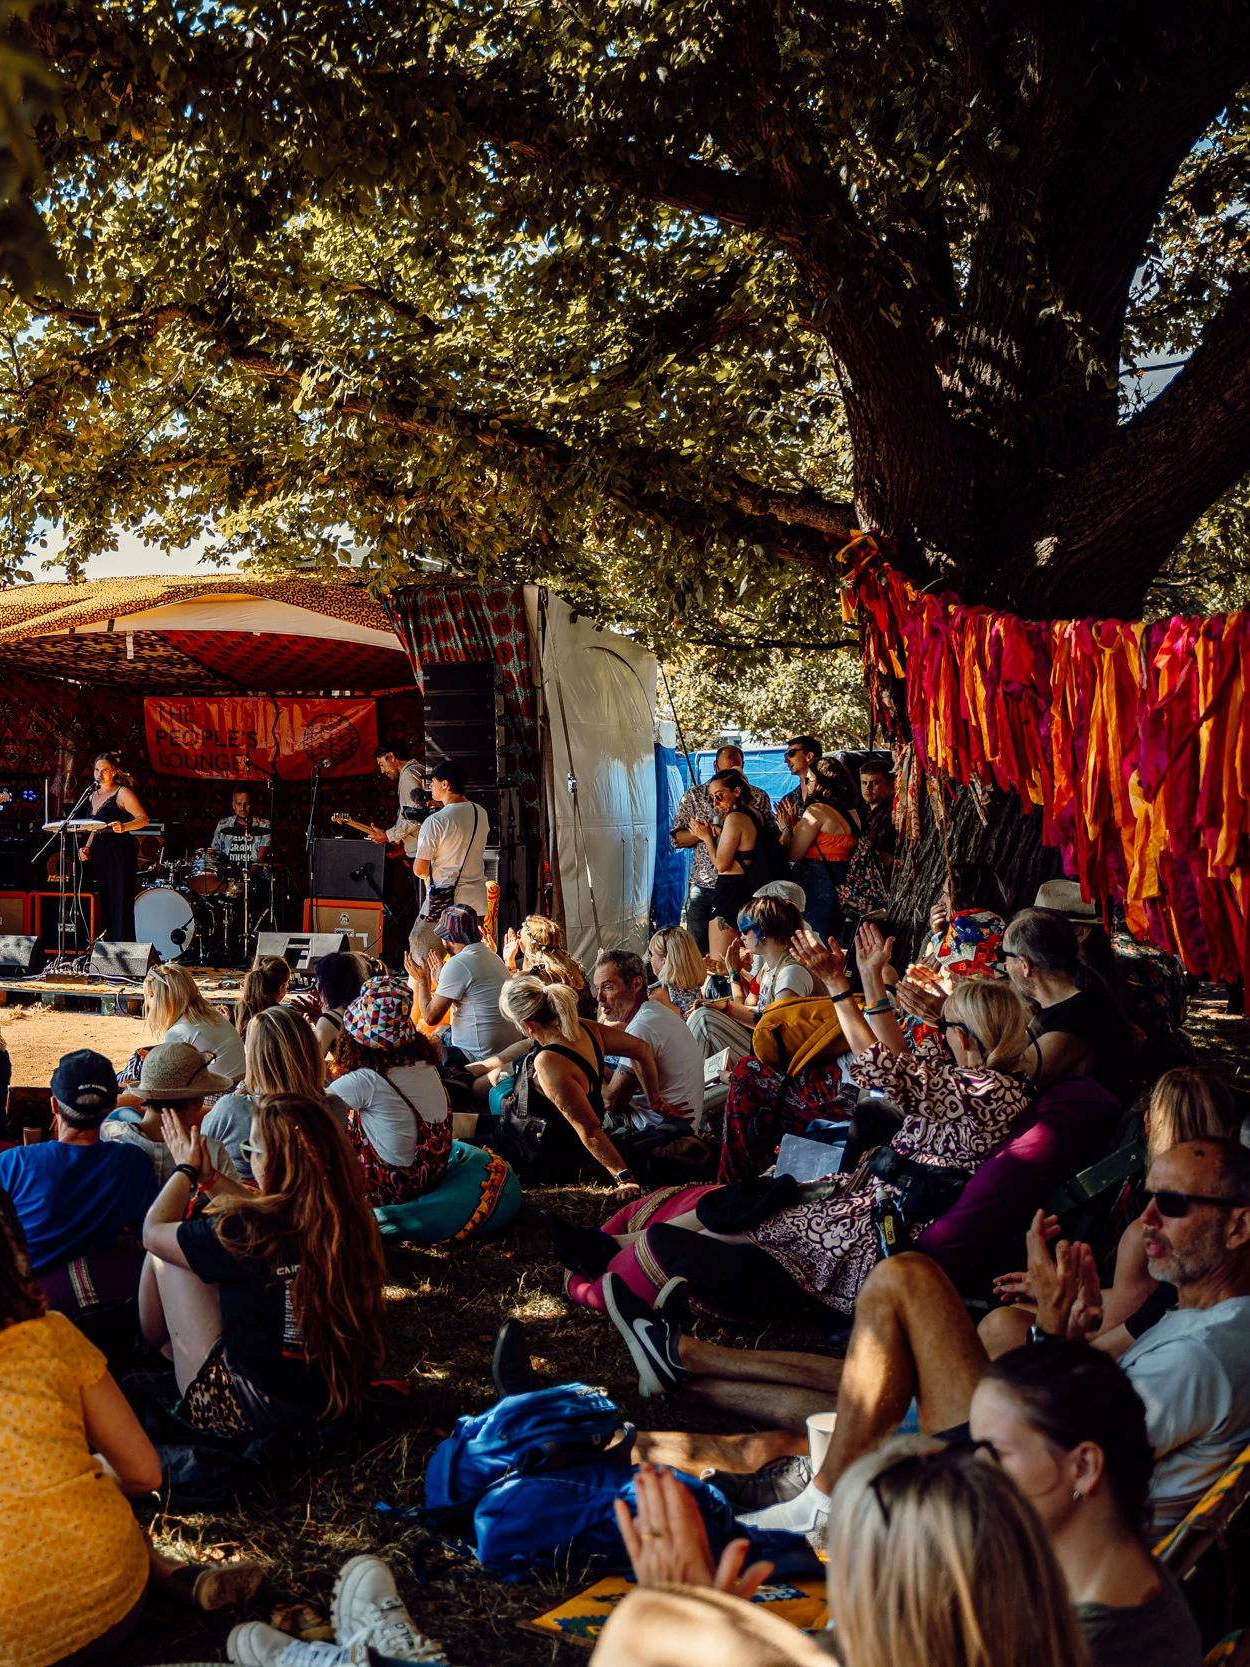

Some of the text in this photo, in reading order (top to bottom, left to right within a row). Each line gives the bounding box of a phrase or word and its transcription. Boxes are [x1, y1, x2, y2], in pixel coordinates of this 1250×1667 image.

[155, 705, 196, 723] THE
[155, 729, 258, 748] PEOPLE'S
[158, 751, 246, 772] LOUNGE
